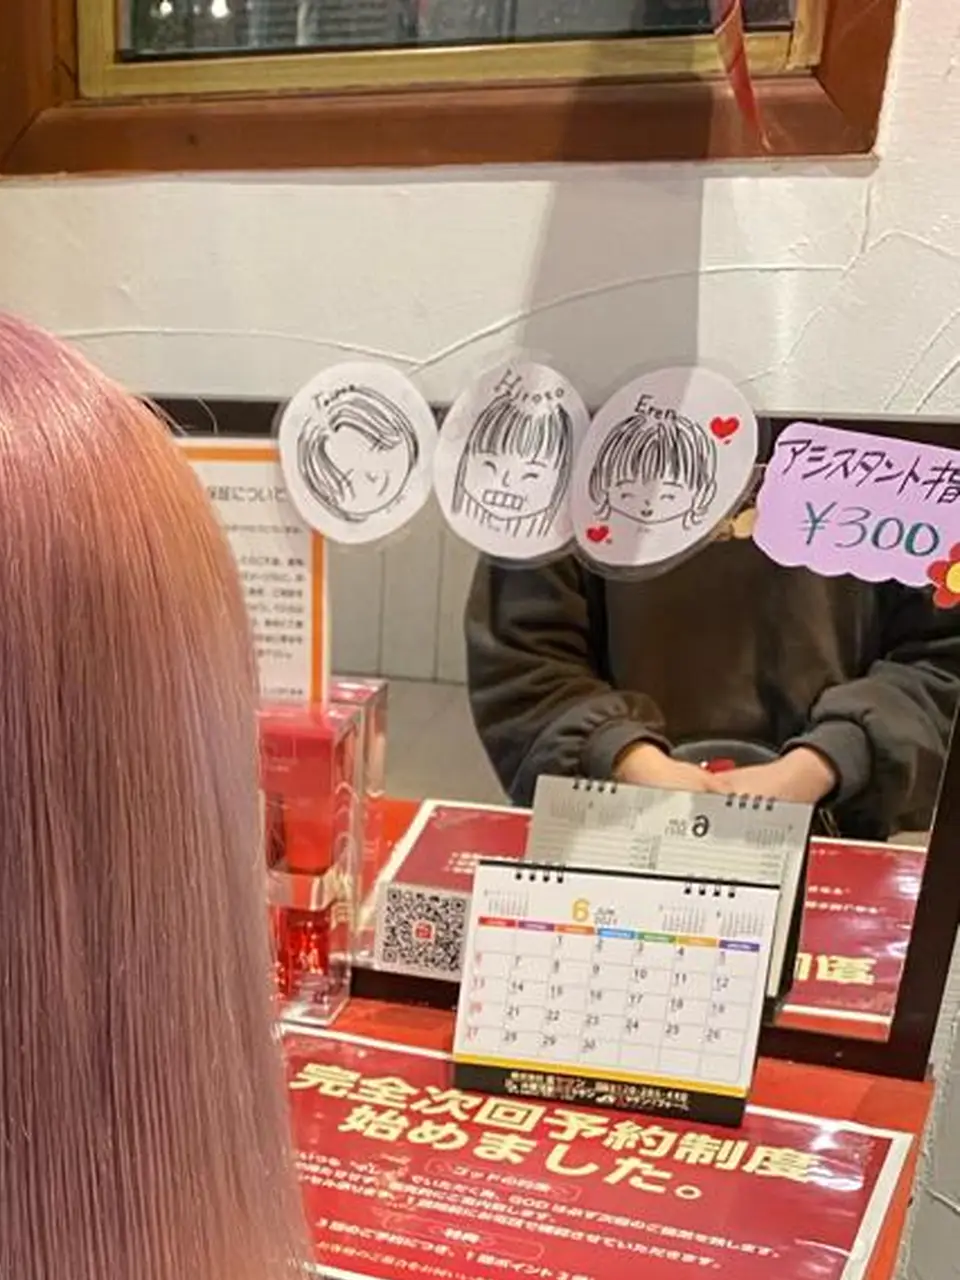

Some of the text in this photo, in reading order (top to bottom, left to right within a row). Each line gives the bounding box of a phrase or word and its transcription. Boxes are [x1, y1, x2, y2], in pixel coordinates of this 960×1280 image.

[800, 502, 939, 557] ¥300
[573, 898, 589, 923] 6
[634, 969, 647, 981] 10
[289, 1062, 814, 1183] 完全次回予約制度
[337, 1104, 703, 1200] 始めました。
